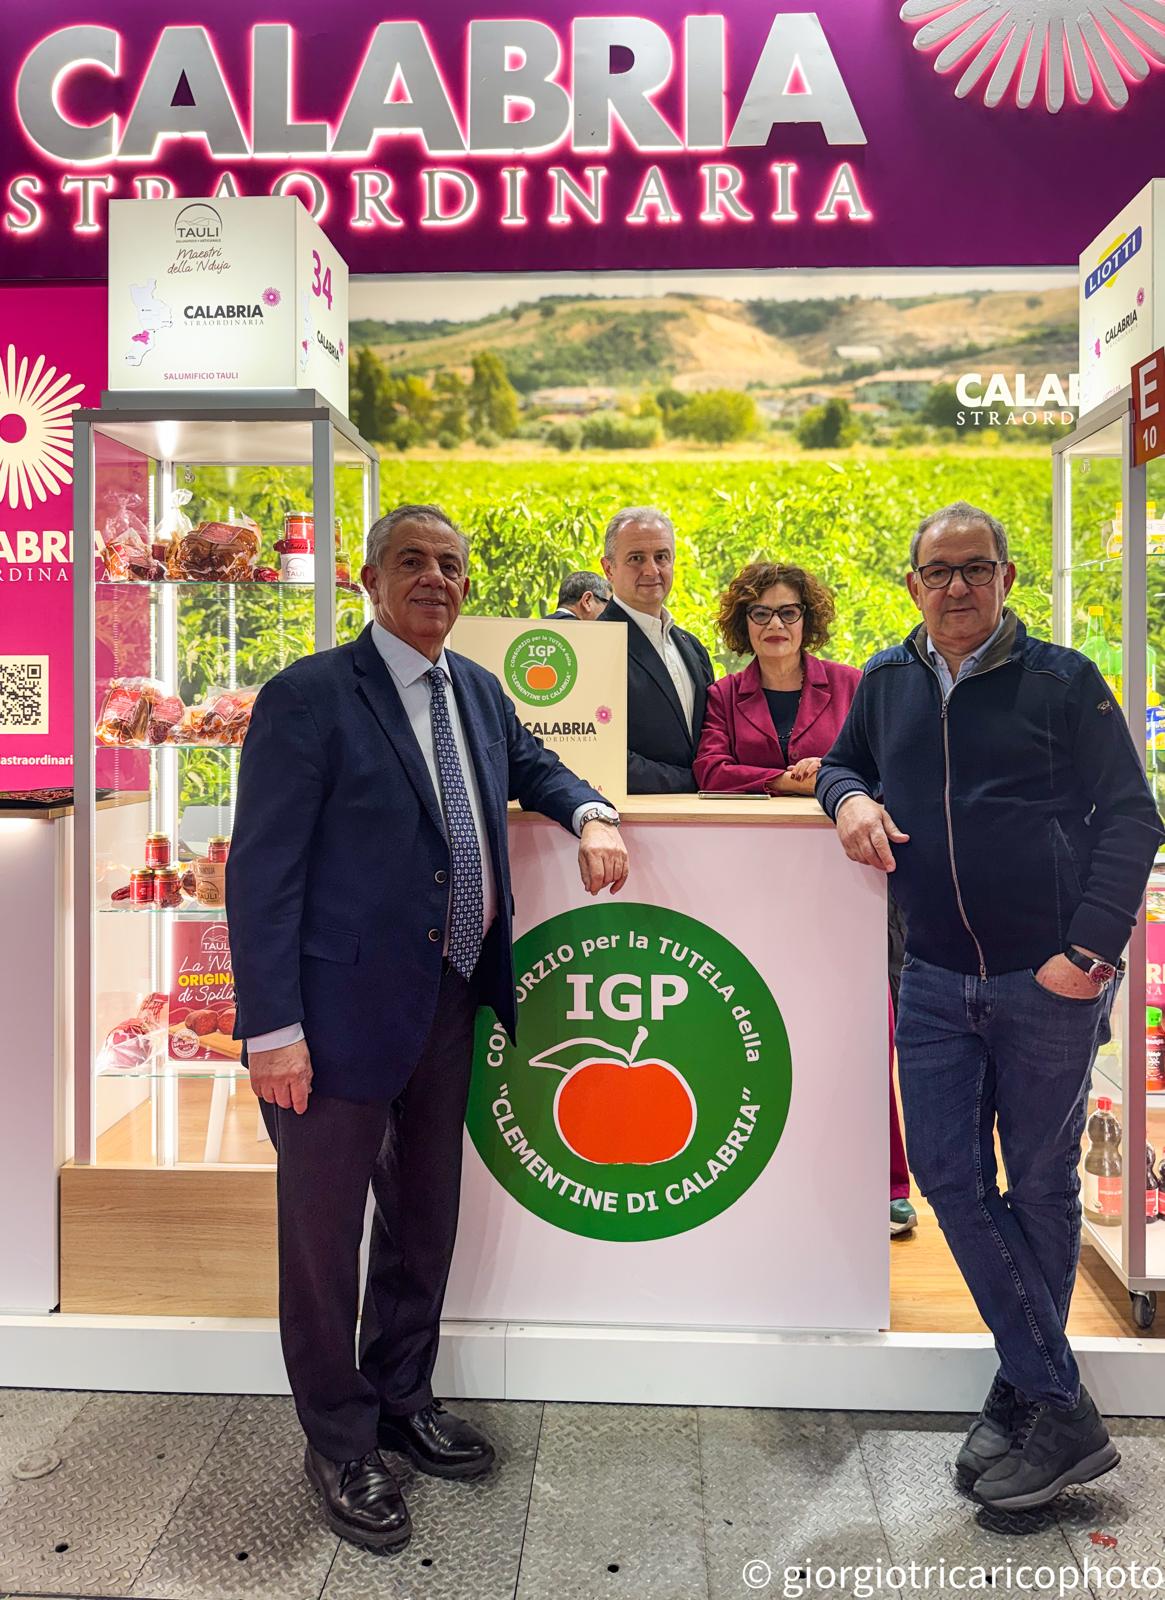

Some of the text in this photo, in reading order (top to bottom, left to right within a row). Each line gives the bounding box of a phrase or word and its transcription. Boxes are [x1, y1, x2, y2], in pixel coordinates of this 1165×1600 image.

[17, 12, 868, 161] CALABRIA
[177, 227, 219, 238] TAULI
[176, 246, 222, 260] Maestri
[167, 259, 193, 274] della
[1088, 233, 1137, 293] LIOTTI
[311, 249, 333, 311] 34
[183, 304, 263, 319] CALABRIA
[1104, 309, 1138, 344] CALABRIA
[316, 329, 340, 362] CALABRIA
[163, 372, 239, 381] SALUMIFICIO TAULI
[1138, 358, 1161, 421] E
[1142, 426, 1158, 452] 10
[528, 645, 556, 657] IGP
[202, 942, 231, 951] TAUL
[179, 956, 204, 973] La
[177, 972, 235, 987] ORIGIN
[178, 987, 193, 1003] di
[486, 931, 763, 1068] COORZIO per la TUTELA della
[565, 973, 689, 1021] IGP
[627, 1191, 659, 1213] DI
